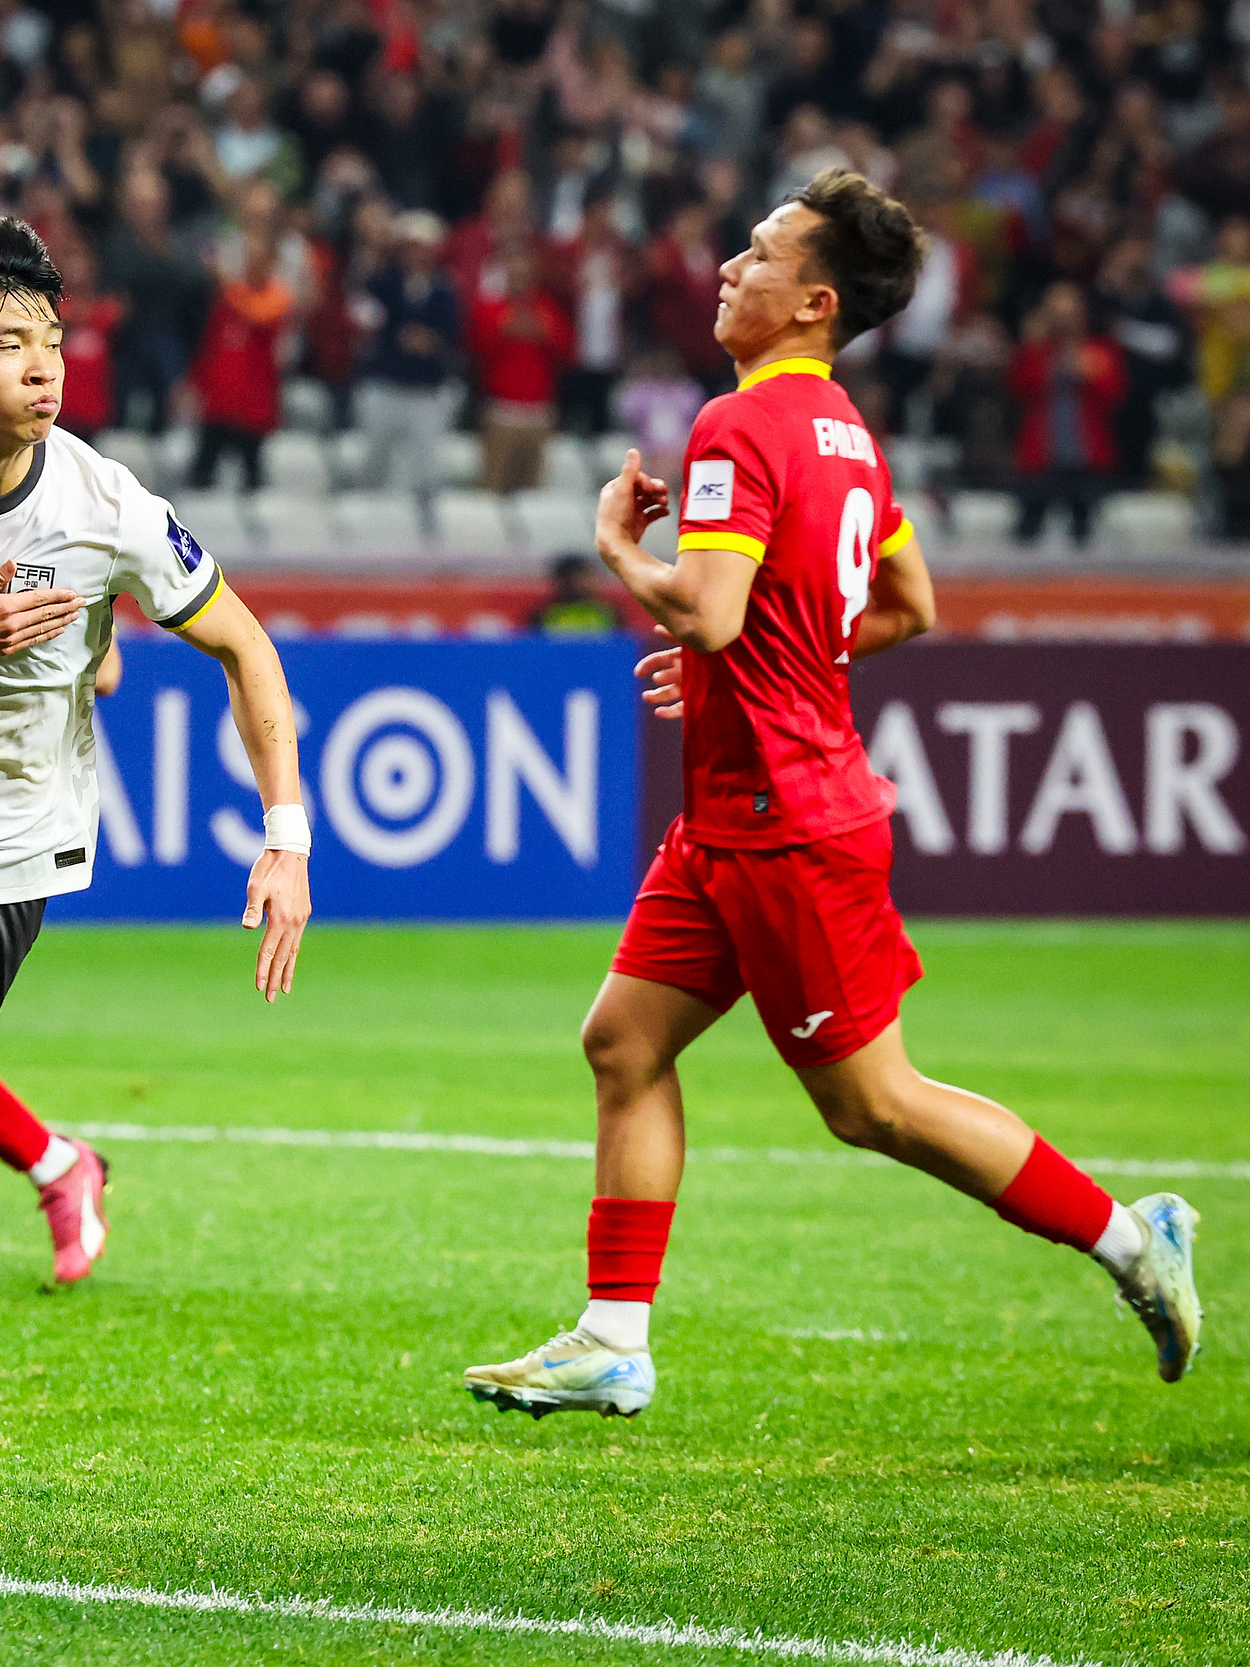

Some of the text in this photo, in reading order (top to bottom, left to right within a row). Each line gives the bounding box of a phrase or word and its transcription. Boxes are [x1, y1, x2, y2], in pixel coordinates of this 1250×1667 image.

[694, 483, 727, 496] AFC
[836, 487, 874, 639] 9
[14, 567, 51, 583] CFA
[23, 580, 39, 589] 中国
